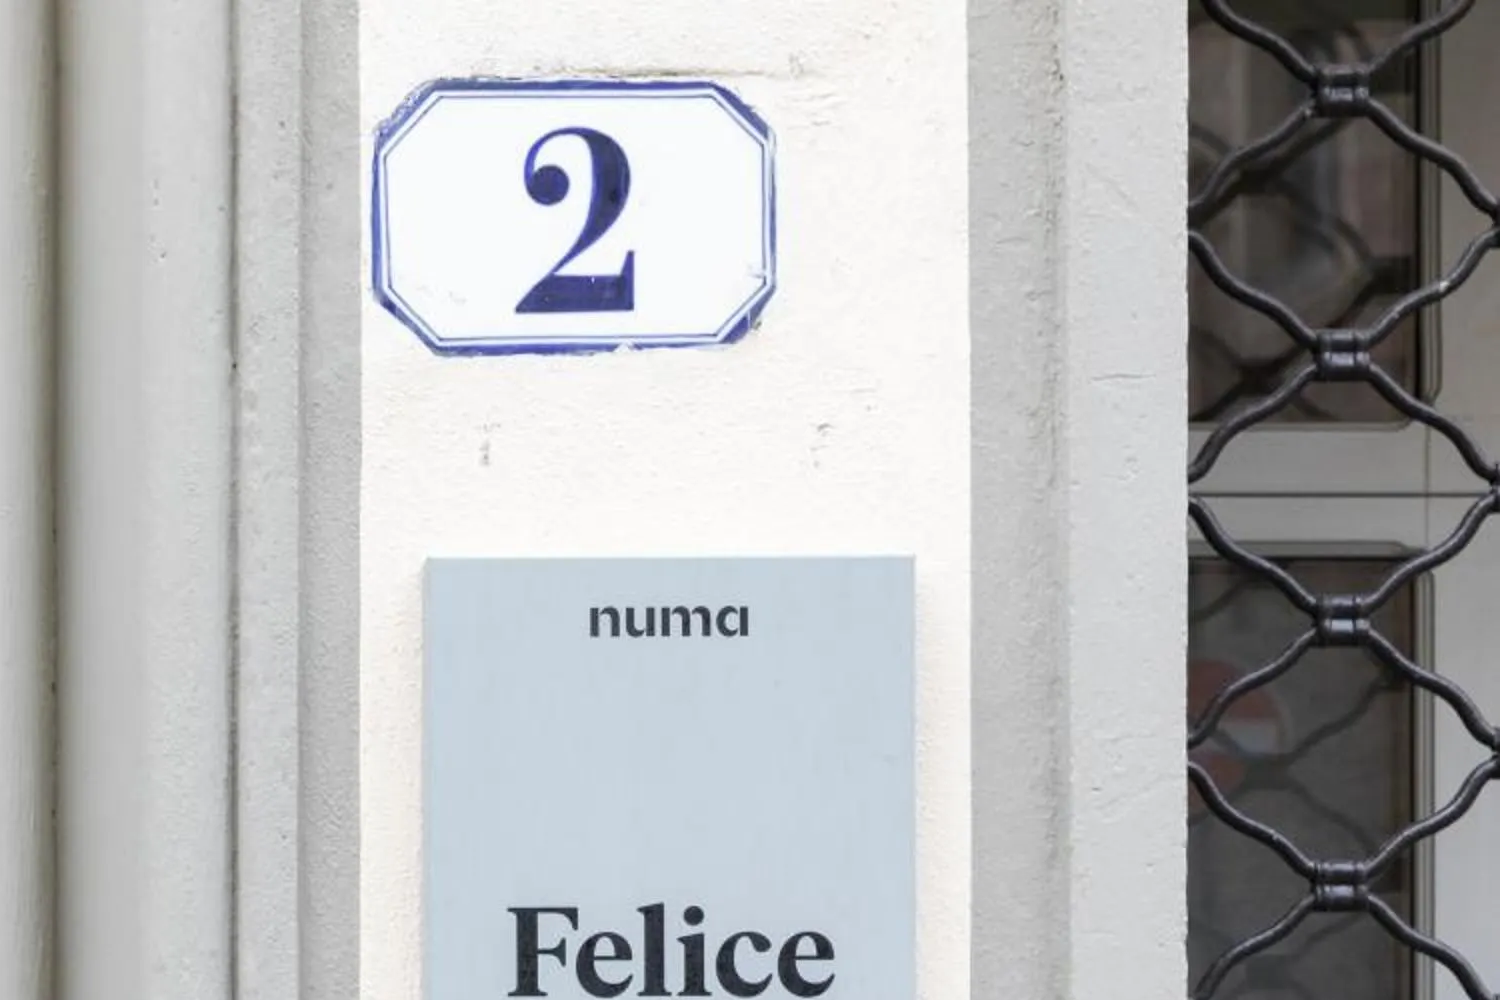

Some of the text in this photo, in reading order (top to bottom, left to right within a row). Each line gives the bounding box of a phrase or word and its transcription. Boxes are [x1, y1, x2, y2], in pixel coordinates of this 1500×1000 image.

[514, 126, 636, 315] 2
[589, 605, 749, 638] numa
[506, 901, 836, 999] Felice
